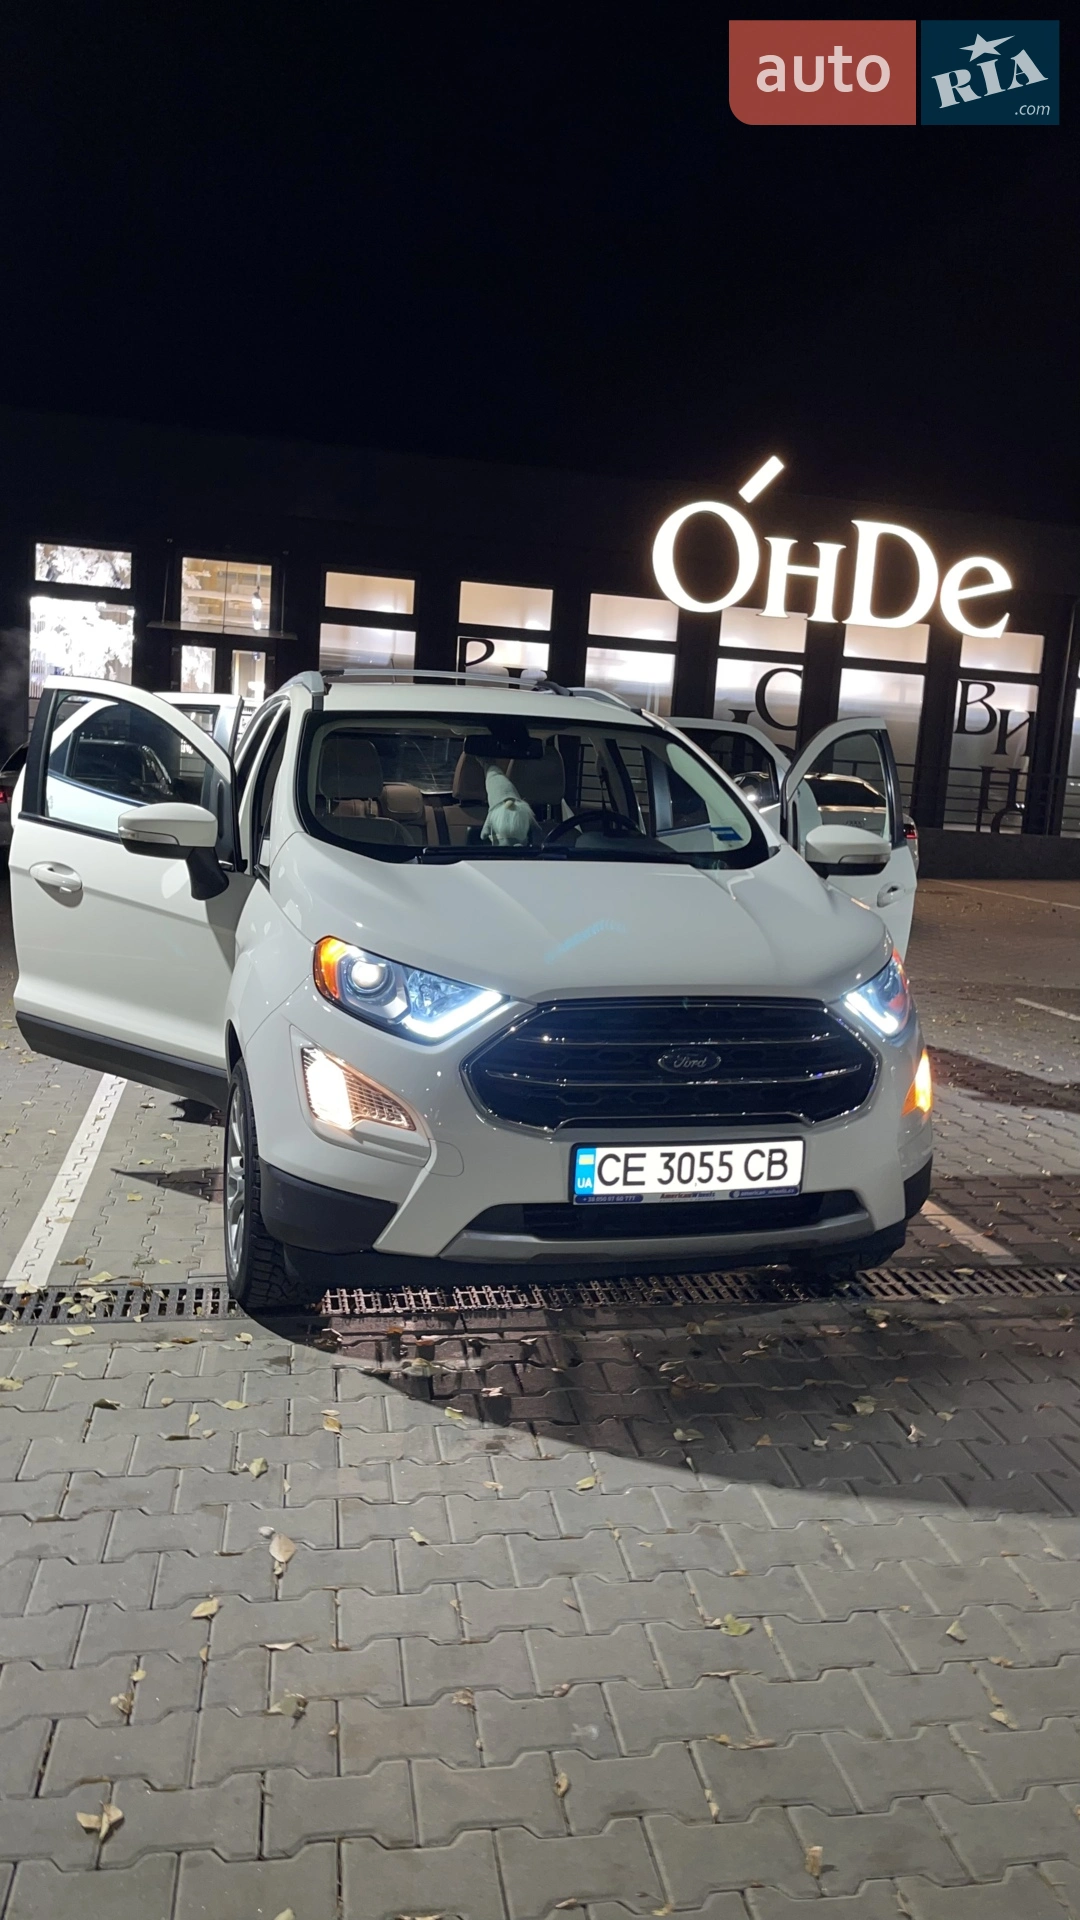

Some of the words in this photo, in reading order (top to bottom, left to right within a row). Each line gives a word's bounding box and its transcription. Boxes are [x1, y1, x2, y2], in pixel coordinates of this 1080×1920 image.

[673, 1055, 708, 1069] Ford
[597, 1152, 647, 1187] CE
[657, 1150, 733, 1186] 3055
[743, 1148, 789, 1182] CB
[577, 1177, 593, 1189] UA
